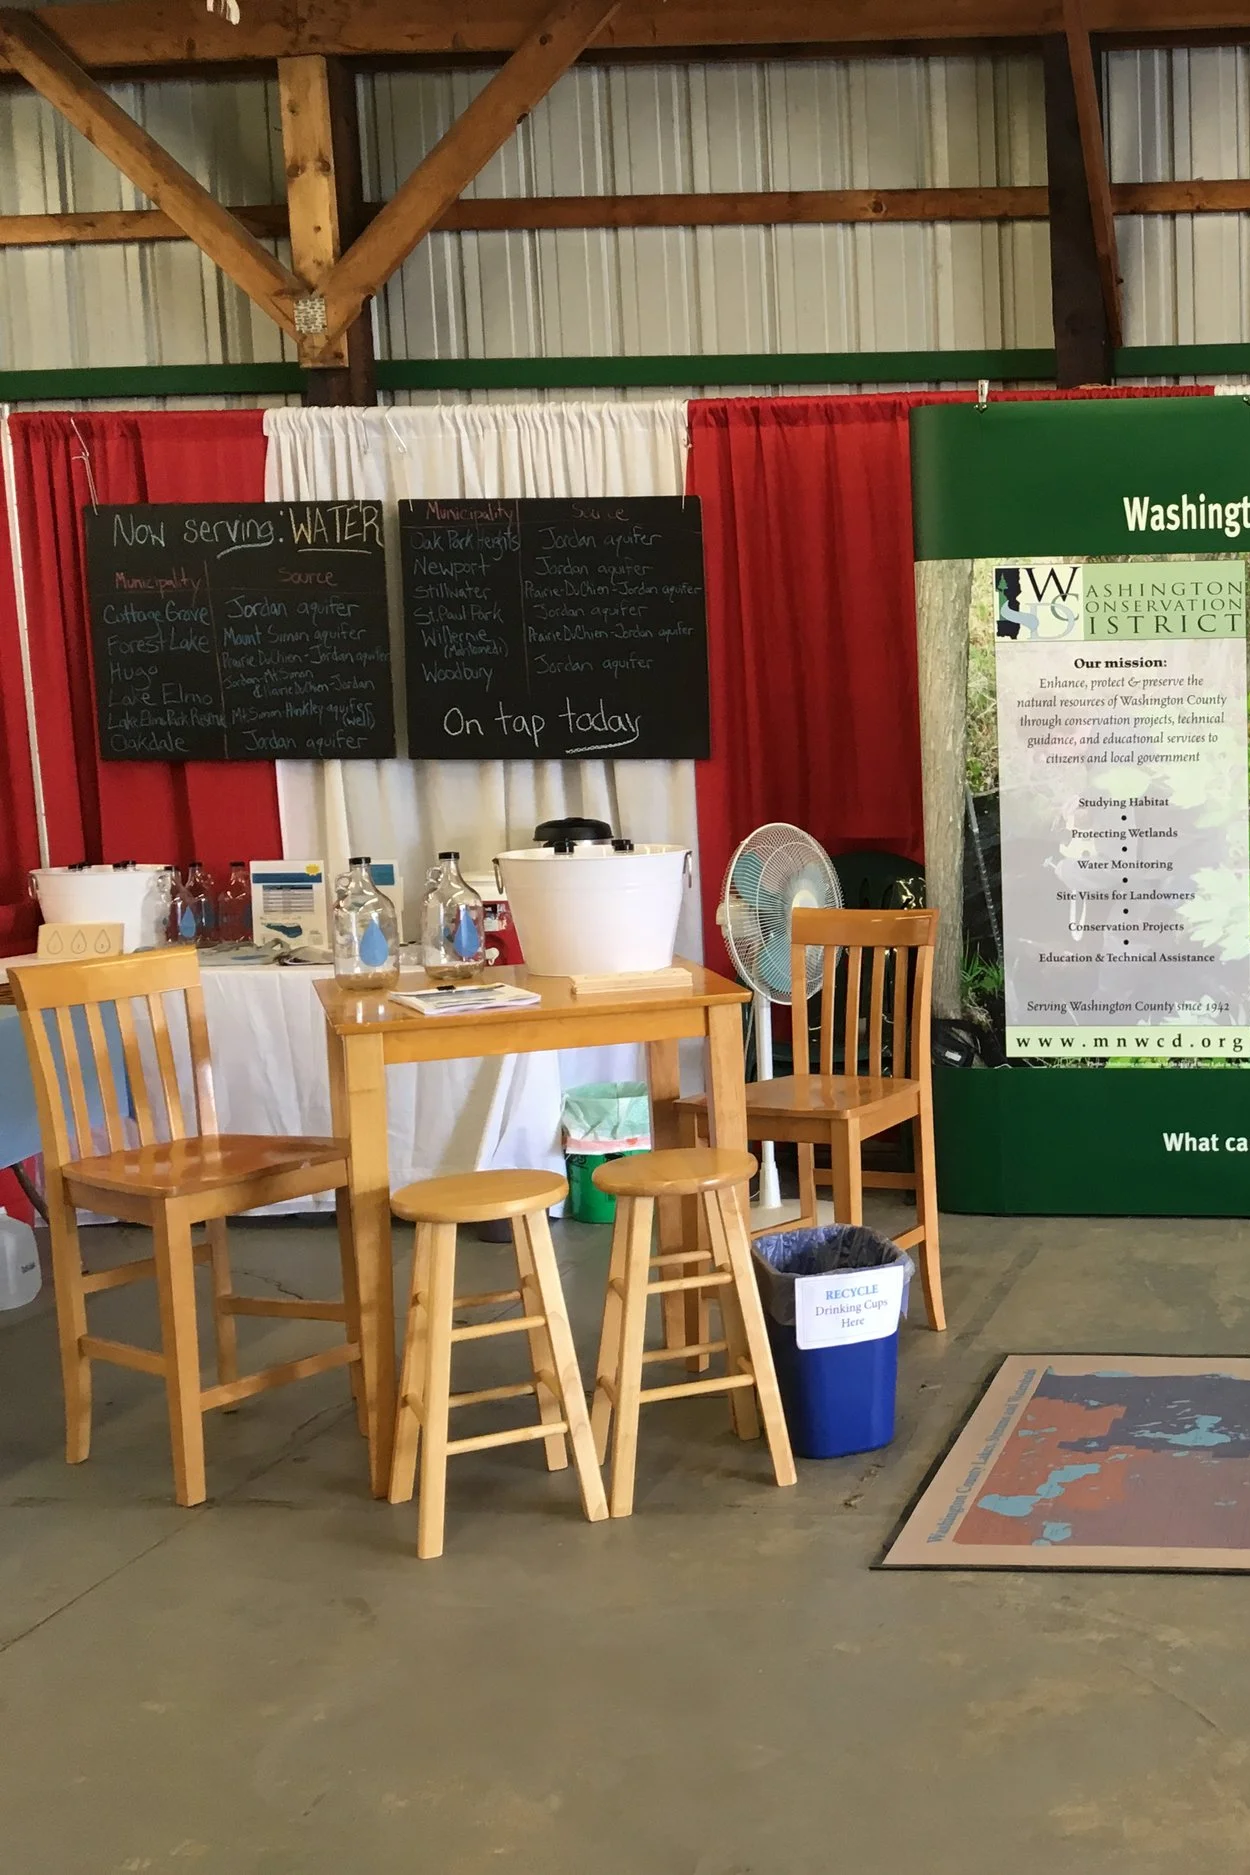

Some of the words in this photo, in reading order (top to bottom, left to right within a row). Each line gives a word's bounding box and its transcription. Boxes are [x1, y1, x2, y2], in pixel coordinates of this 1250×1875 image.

[290, 504, 384, 547] WATER
[279, 567, 337, 586] Source
[413, 554, 490, 580] Newport
[115, 566, 201, 605] Municipality
[412, 581, 491, 600] Stillwater
[103, 602, 162, 634] Cottage
[165, 601, 210, 626] Grove
[226, 596, 288, 620] Jordan
[296, 596, 359, 626] aquifer
[107, 633, 168, 656] Forest
[170, 627, 210, 654] Lake
[1074, 658, 1102, 669] Our
[1105, 657, 1167, 669] mission:
[110, 661, 158, 691] Hugo
[421, 660, 494, 692] Woodbury
[1039, 678, 1088, 690] Enhance,
[1091, 677, 1125, 691] protect
[1128, 677, 1141, 687] &
[1142, 677, 1184, 691] preserve
[1187, 675, 1204, 686] the
[443, 707, 484, 736] On
[494, 701, 545, 748] tap
[559, 697, 641, 738] today
[110, 731, 190, 752] Oakdale
[242, 728, 296, 750] Jordan
[306, 731, 368, 755] aquifer
[1079, 798, 1127, 809] Studying
[1129, 797, 1169, 807] Habitat
[1071, 829, 1126, 841] Protecting
[1128, 828, 1178, 838] Wetlands
[1077, 860, 1109, 869] Water
[1111, 860, 1173, 871] Monitoring
[1056, 891, 1077, 901] Site
[1079, 891, 1109, 901] Visits
[1111, 891, 1127, 901] for
[1130, 891, 1195, 901] Landowners
[1068, 922, 1139, 932] Conservation
[1143, 922, 1184, 934] Projects
[1039, 953, 1093, 963] Education
[1095, 954, 1105, 963] &
[1106, 953, 1157, 963] Technical
[1159, 953, 1215, 963] Assistance
[1027, 1001, 1067, 1014] Serving
[1070, 1000, 1132, 1014] Washington
[1135, 1001, 1175, 1013] County
[1177, 1001, 1202, 1012] since
[1206, 1002, 1230, 1014] 1942
[1016, 1034, 1243, 1052] www.mnwcd.org
[1163, 1133, 1219, 1152] What
[825, 1284, 879, 1300] RECYCLE
[815, 1301, 862, 1317] Drinking
[863, 1299, 888, 1311] Cups
[841, 1318, 865, 1329] Here
